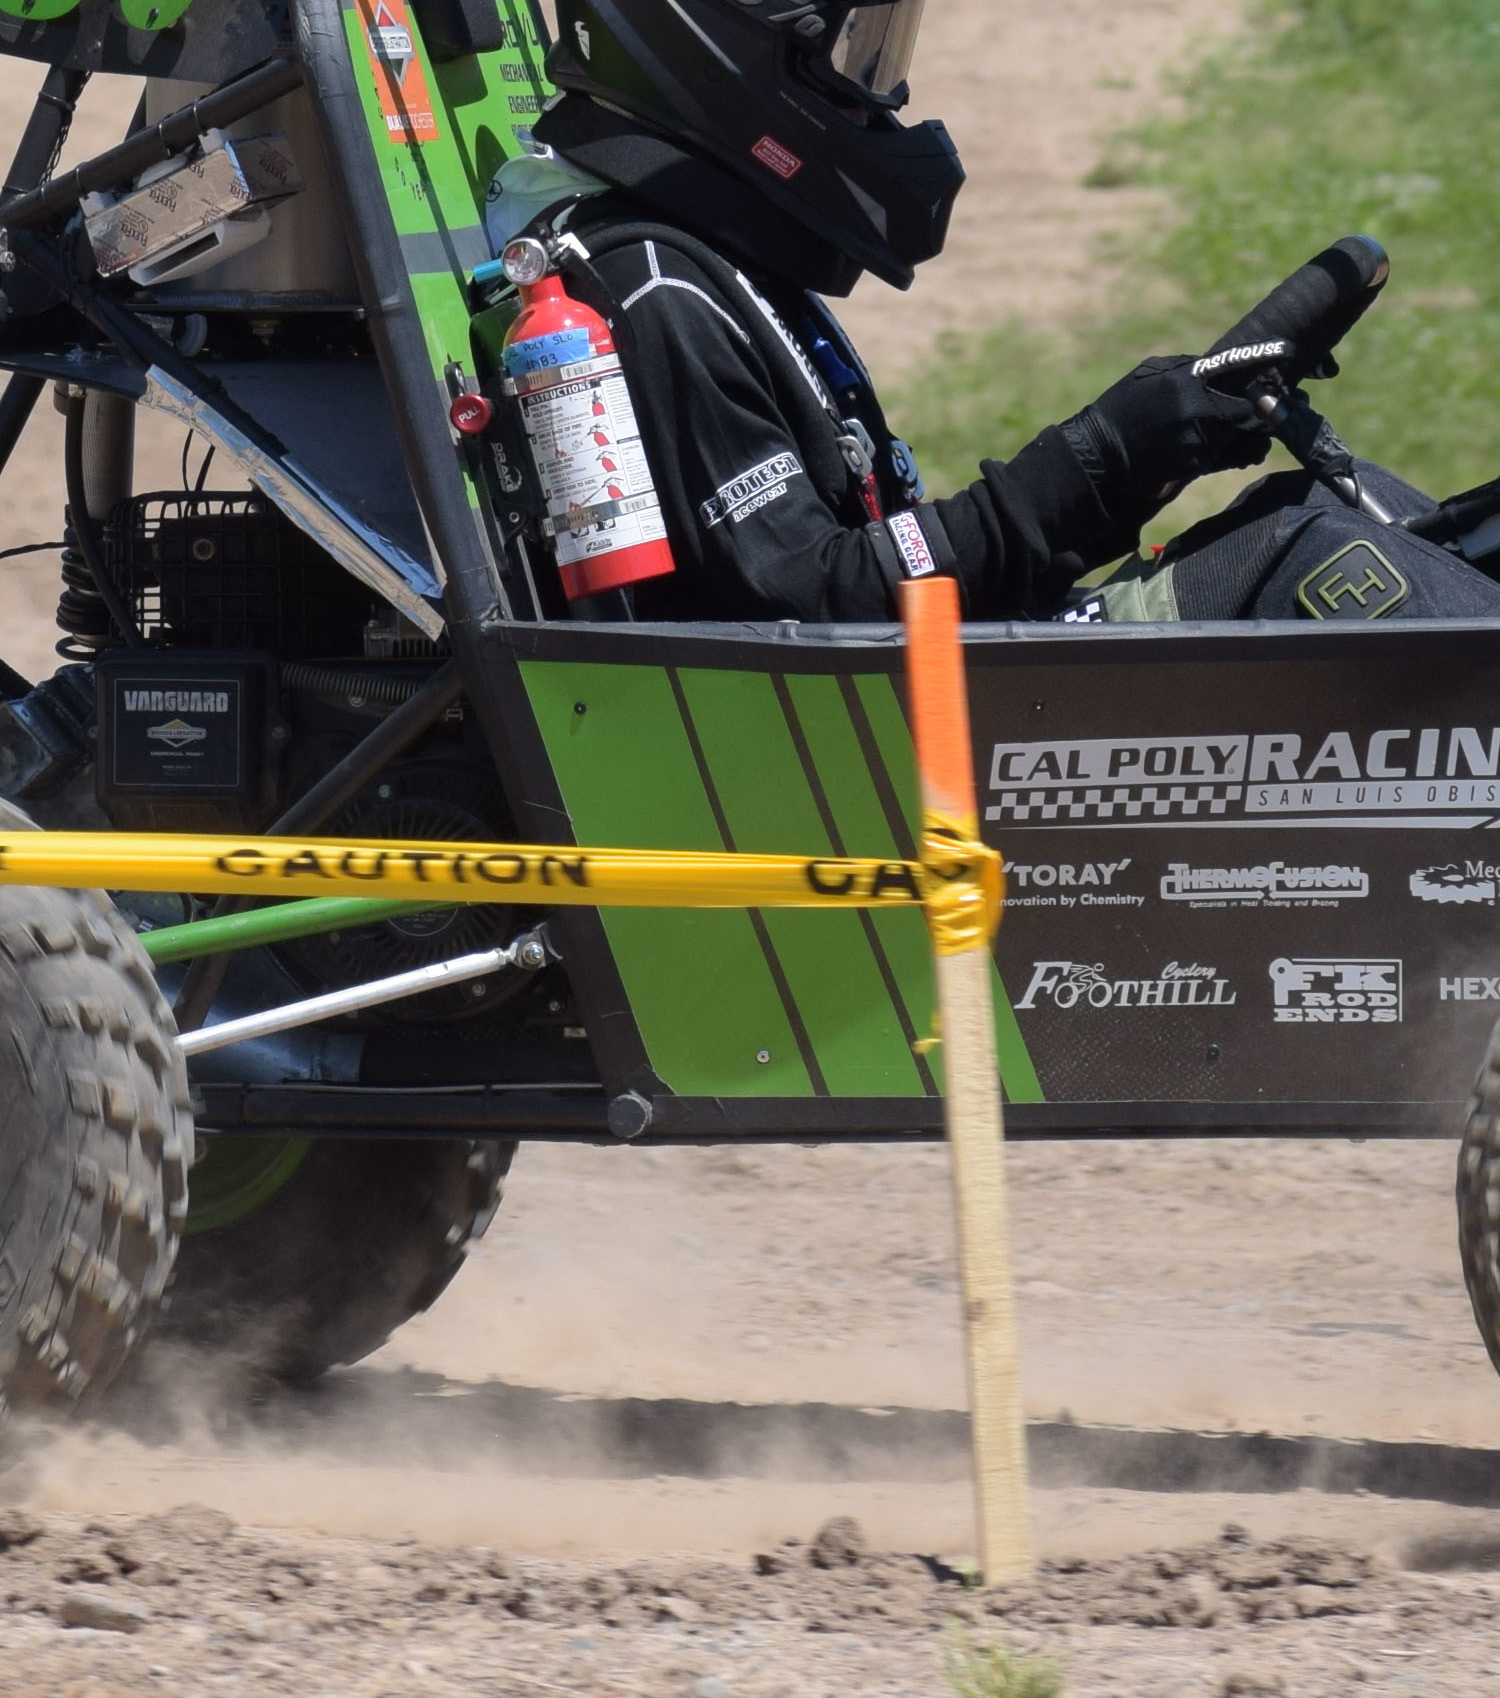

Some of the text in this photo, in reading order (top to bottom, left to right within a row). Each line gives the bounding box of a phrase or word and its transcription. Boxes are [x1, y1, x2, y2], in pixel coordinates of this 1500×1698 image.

[1191, 341, 1286, 377] FASTHOUSE
[123, 690, 229, 713] VANGUARD
[998, 749, 1091, 782] CAL
[1107, 744, 1240, 779] POLY
[1258, 788, 1313, 806] SAN
[1336, 786, 1404, 804] LUIS
[215, 848, 592, 888] CAUTION
[1060, 894, 1077, 908] by
[1080, 893, 1146, 907] Chemistry
[1161, 960, 1217, 980] Cyclery
[1301, 992, 1398, 1007] ROD
[1274, 1008, 1398, 1023] ENDS
